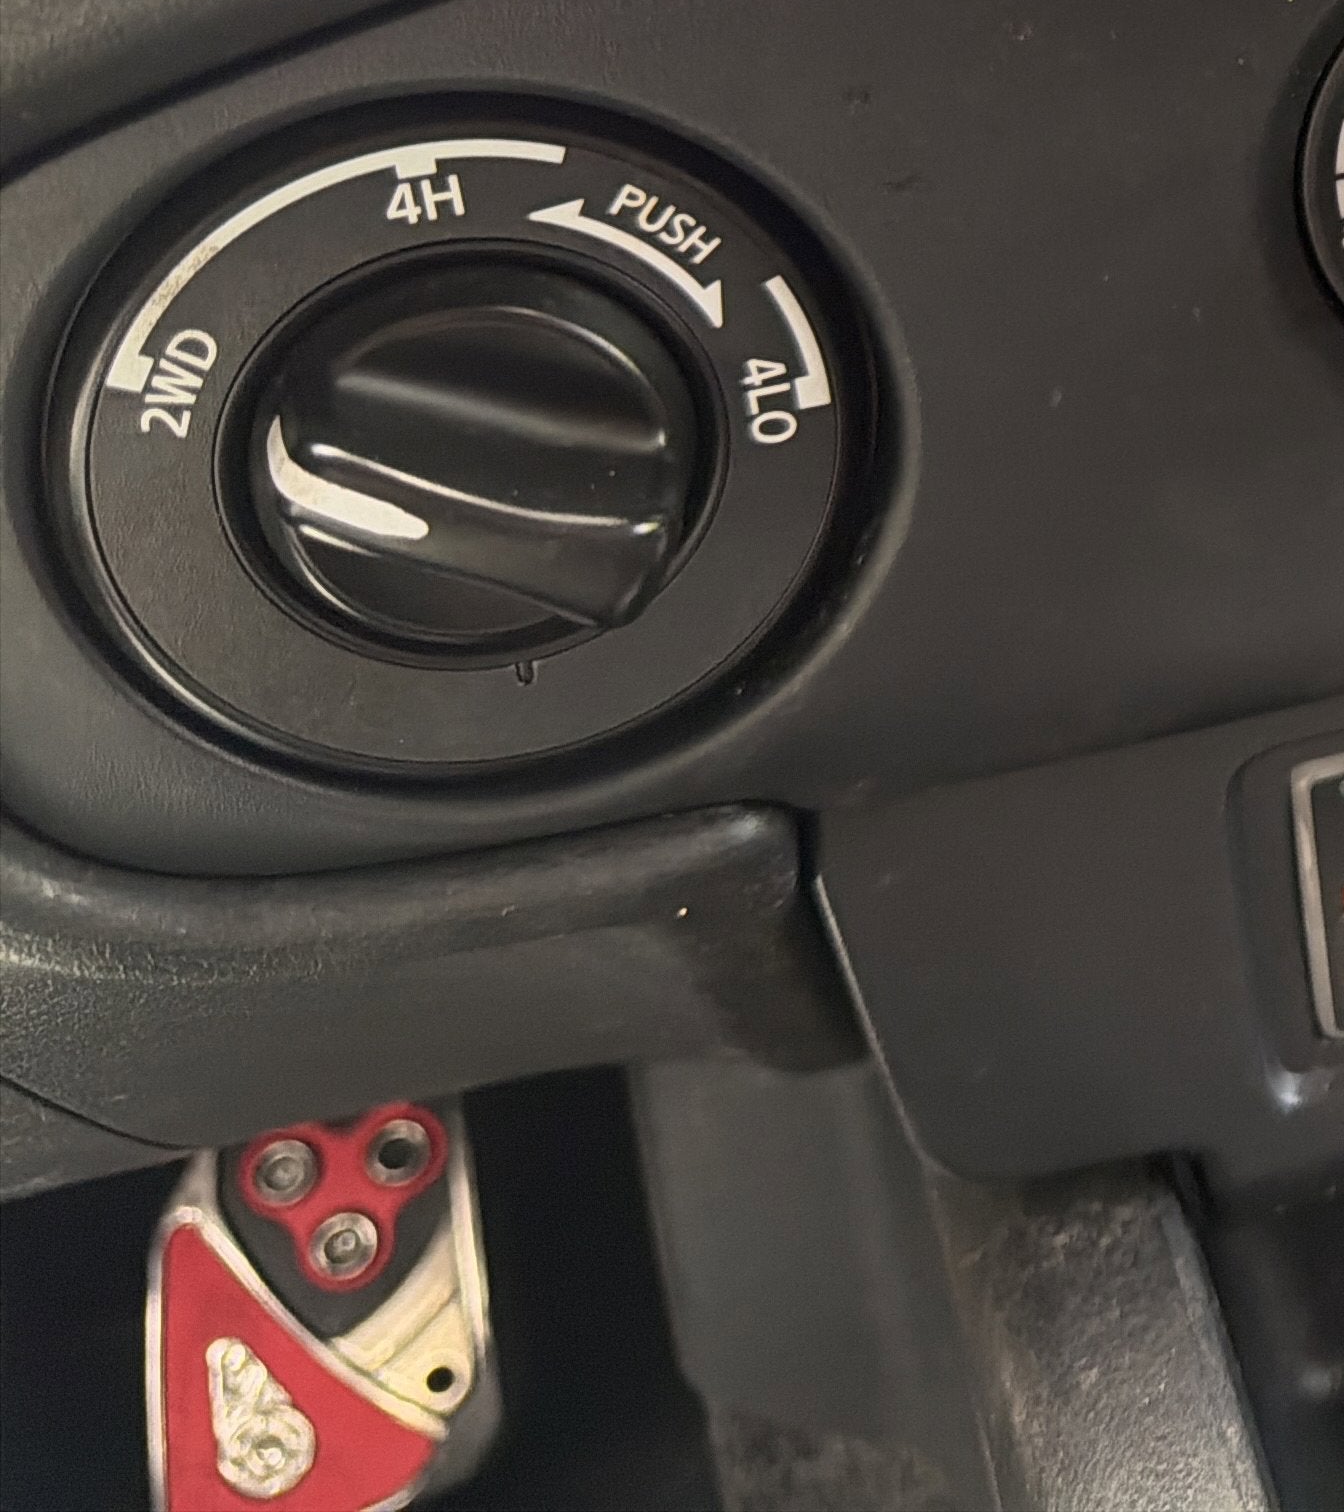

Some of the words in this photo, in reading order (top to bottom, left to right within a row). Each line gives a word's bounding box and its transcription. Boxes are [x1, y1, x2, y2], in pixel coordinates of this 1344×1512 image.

[386, 174, 465, 225] 4H
[609, 183, 721, 265] PUSH
[141, 328, 218, 438] 2WD
[741, 357, 797, 445] 4LO
